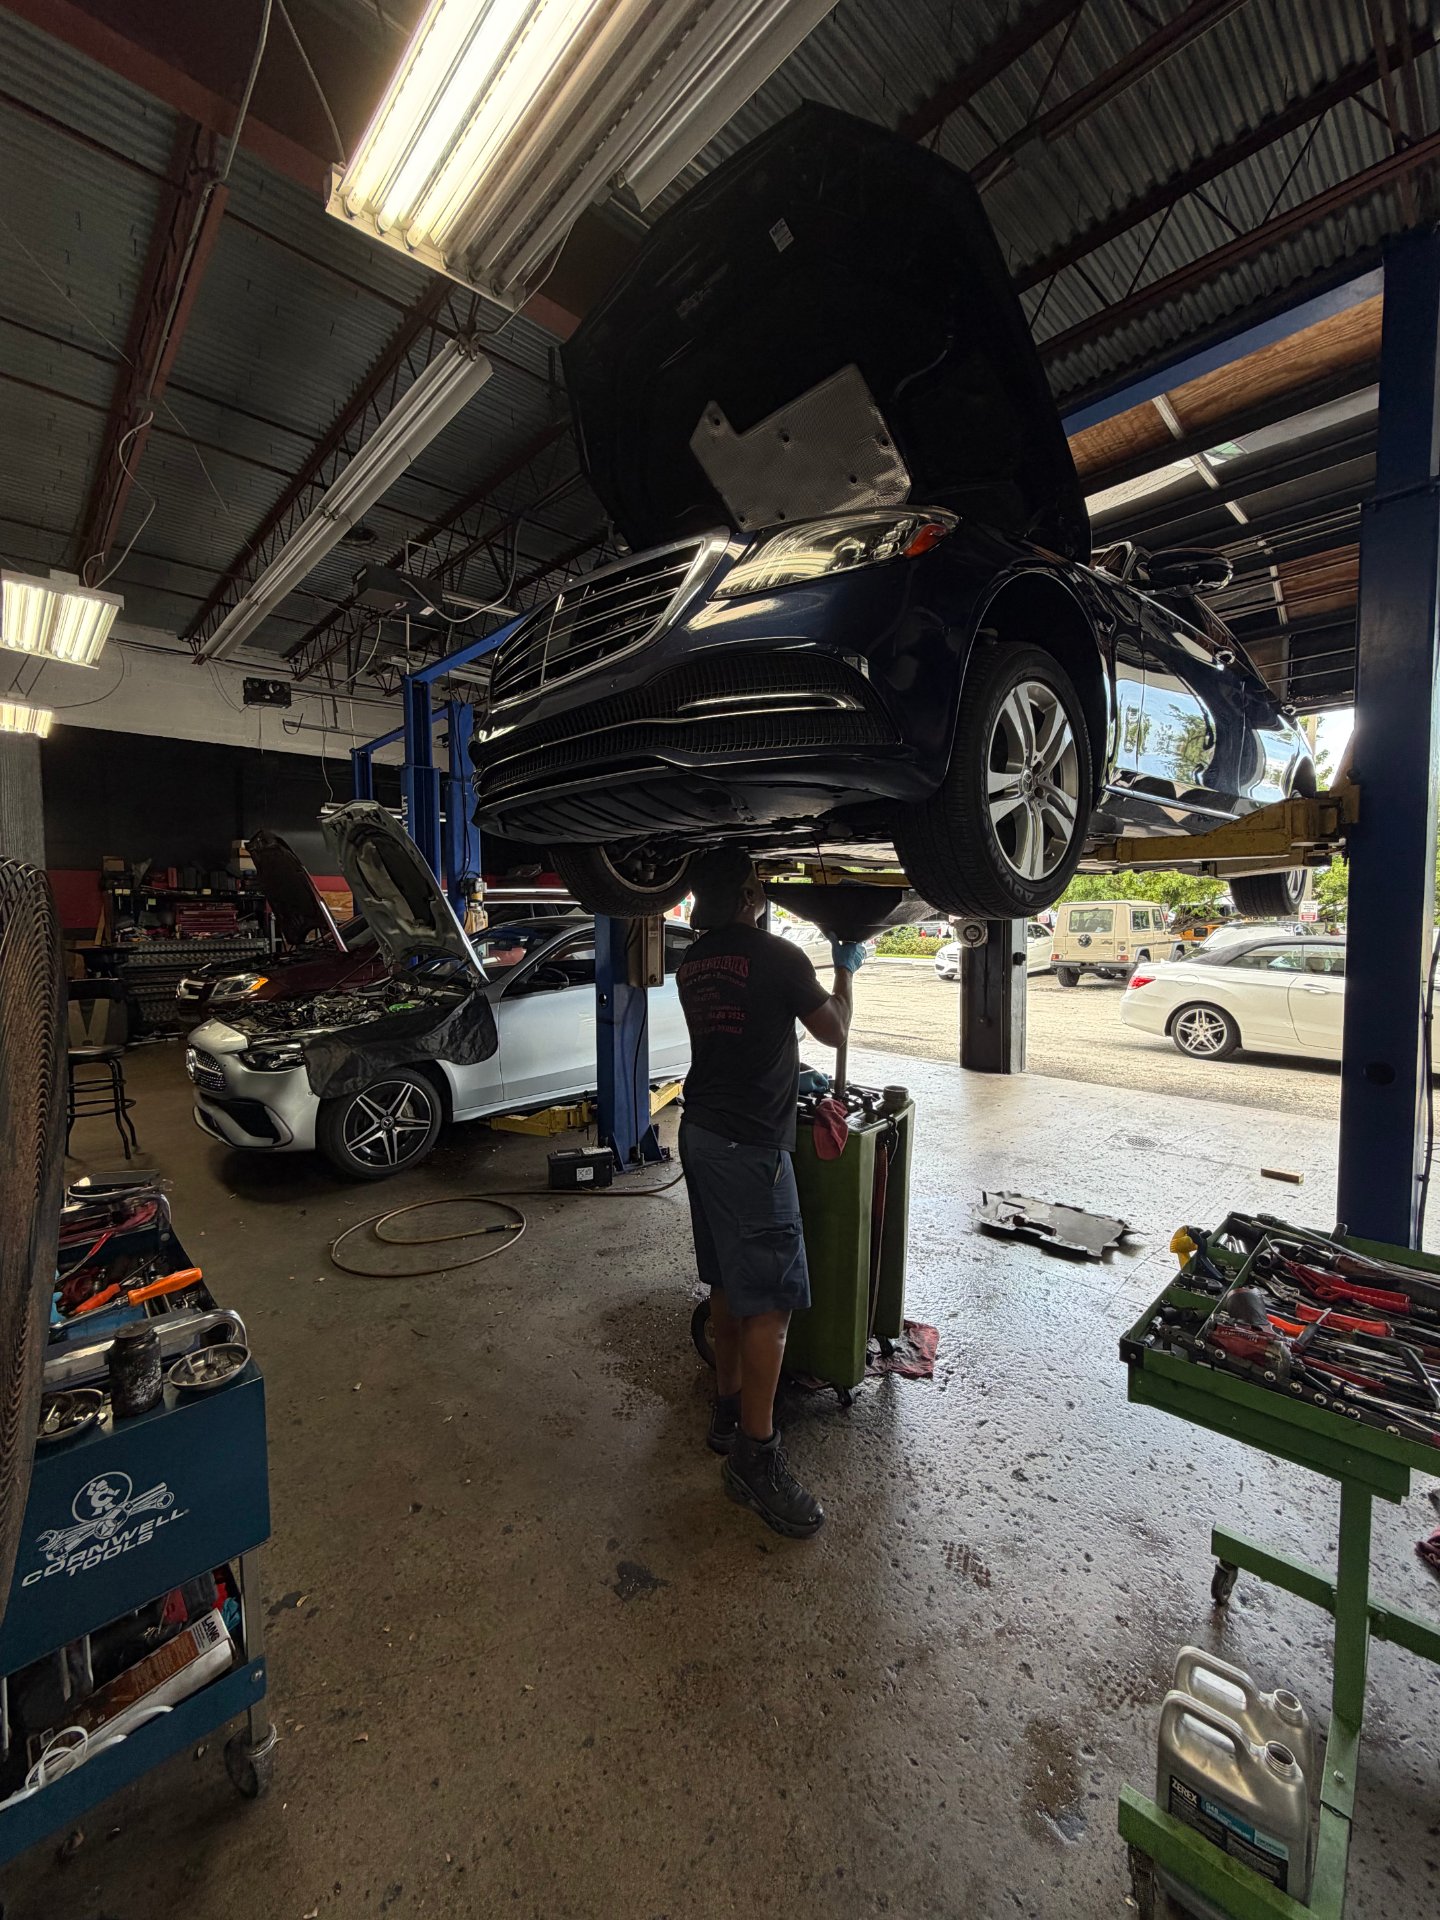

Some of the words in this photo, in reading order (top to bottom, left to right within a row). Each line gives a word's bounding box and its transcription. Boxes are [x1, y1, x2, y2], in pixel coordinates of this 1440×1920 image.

[22, 1509, 185, 1588] CORNWELL
[65, 1530, 154, 1577] TOOLS
[204, 1615, 220, 1643] LANG
[1171, 1778, 1198, 1804] ZEREX
